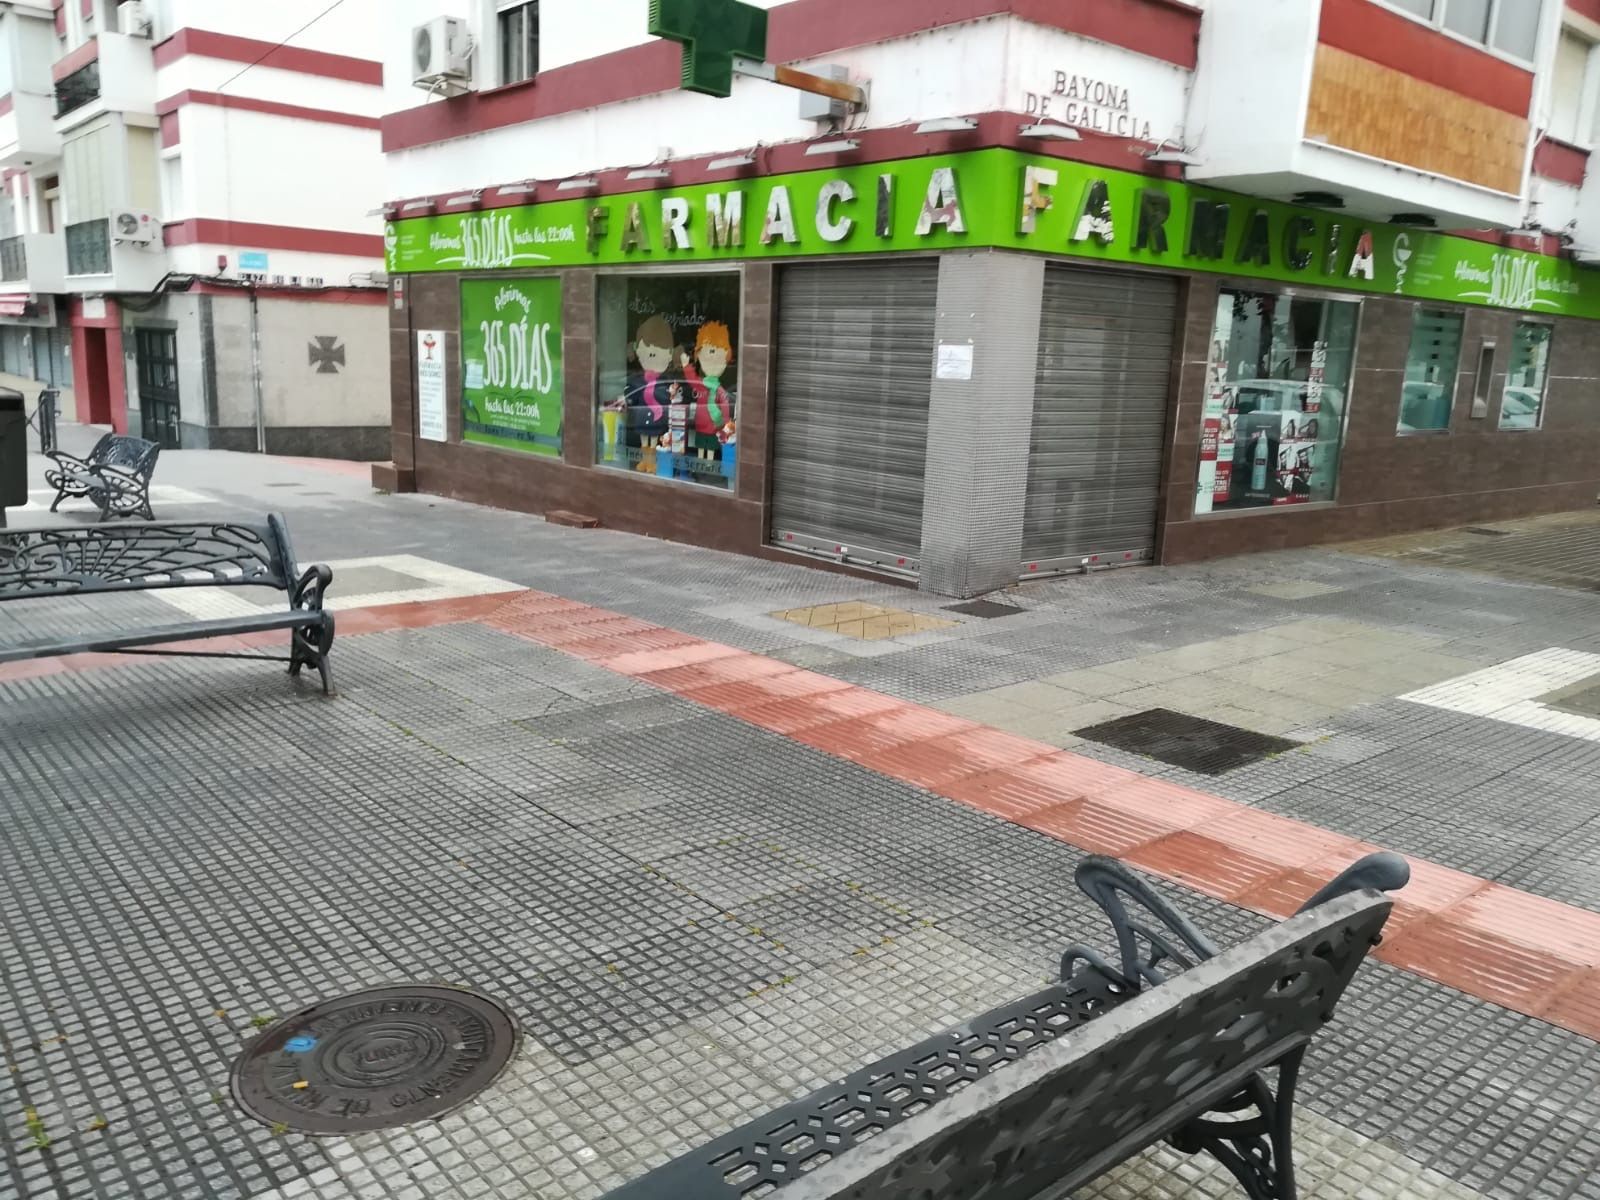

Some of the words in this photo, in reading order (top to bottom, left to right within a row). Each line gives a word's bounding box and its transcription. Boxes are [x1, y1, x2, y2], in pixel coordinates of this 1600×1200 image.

[1052, 70, 1128, 112] BAYONA
[1026, 92, 1051, 117] DE
[1066, 103, 1151, 140] GALICIA
[585, 165, 968, 256] FARMACIA
[1015, 164, 1376, 281] FARMACIA
[494, 285, 532, 314] Abrimos
[480, 320, 508, 389] 365
[508, 315, 553, 395] DÍAS
[485, 396, 503, 413] hasta
[515, 402, 540, 421] 22:00h
